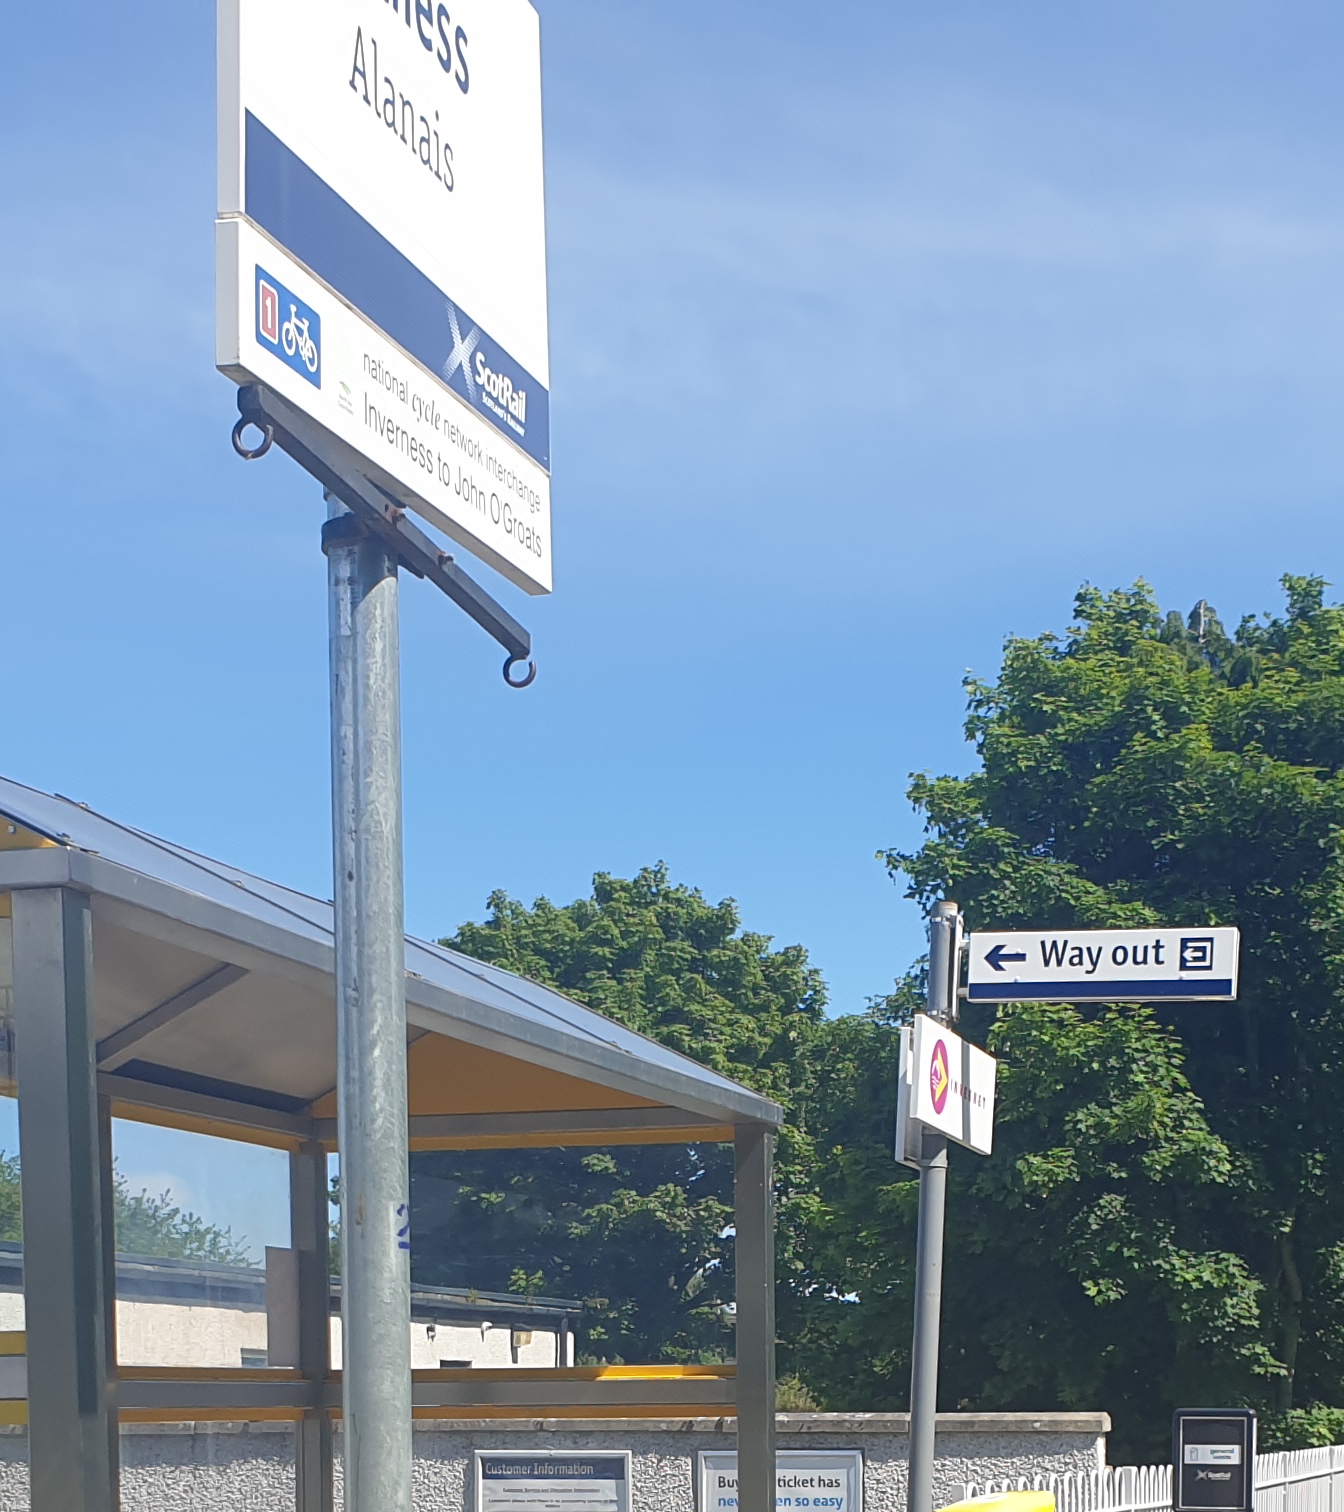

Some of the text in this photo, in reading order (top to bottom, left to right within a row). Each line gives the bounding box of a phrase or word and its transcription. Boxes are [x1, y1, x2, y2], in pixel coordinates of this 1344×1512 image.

[348, 26, 455, 193] Alanais
[265, 296, 272, 329] 1
[475, 351, 527, 424] ScotRail
[363, 353, 409, 406] national
[411, 393, 441, 431] cycle
[443, 417, 484, 467] network
[485, 448, 541, 514] interchange
[364, 391, 543, 559] Inverness to John O'Groats
[1040, 939, 1165, 974] Way out
[485, 1462, 594, 1475] Customer Information
[777, 1475, 814, 1488] ticket
[817, 1475, 841, 1488] has
[795, 1497, 810, 1507] so
[812, 1497, 844, 1510] easy
